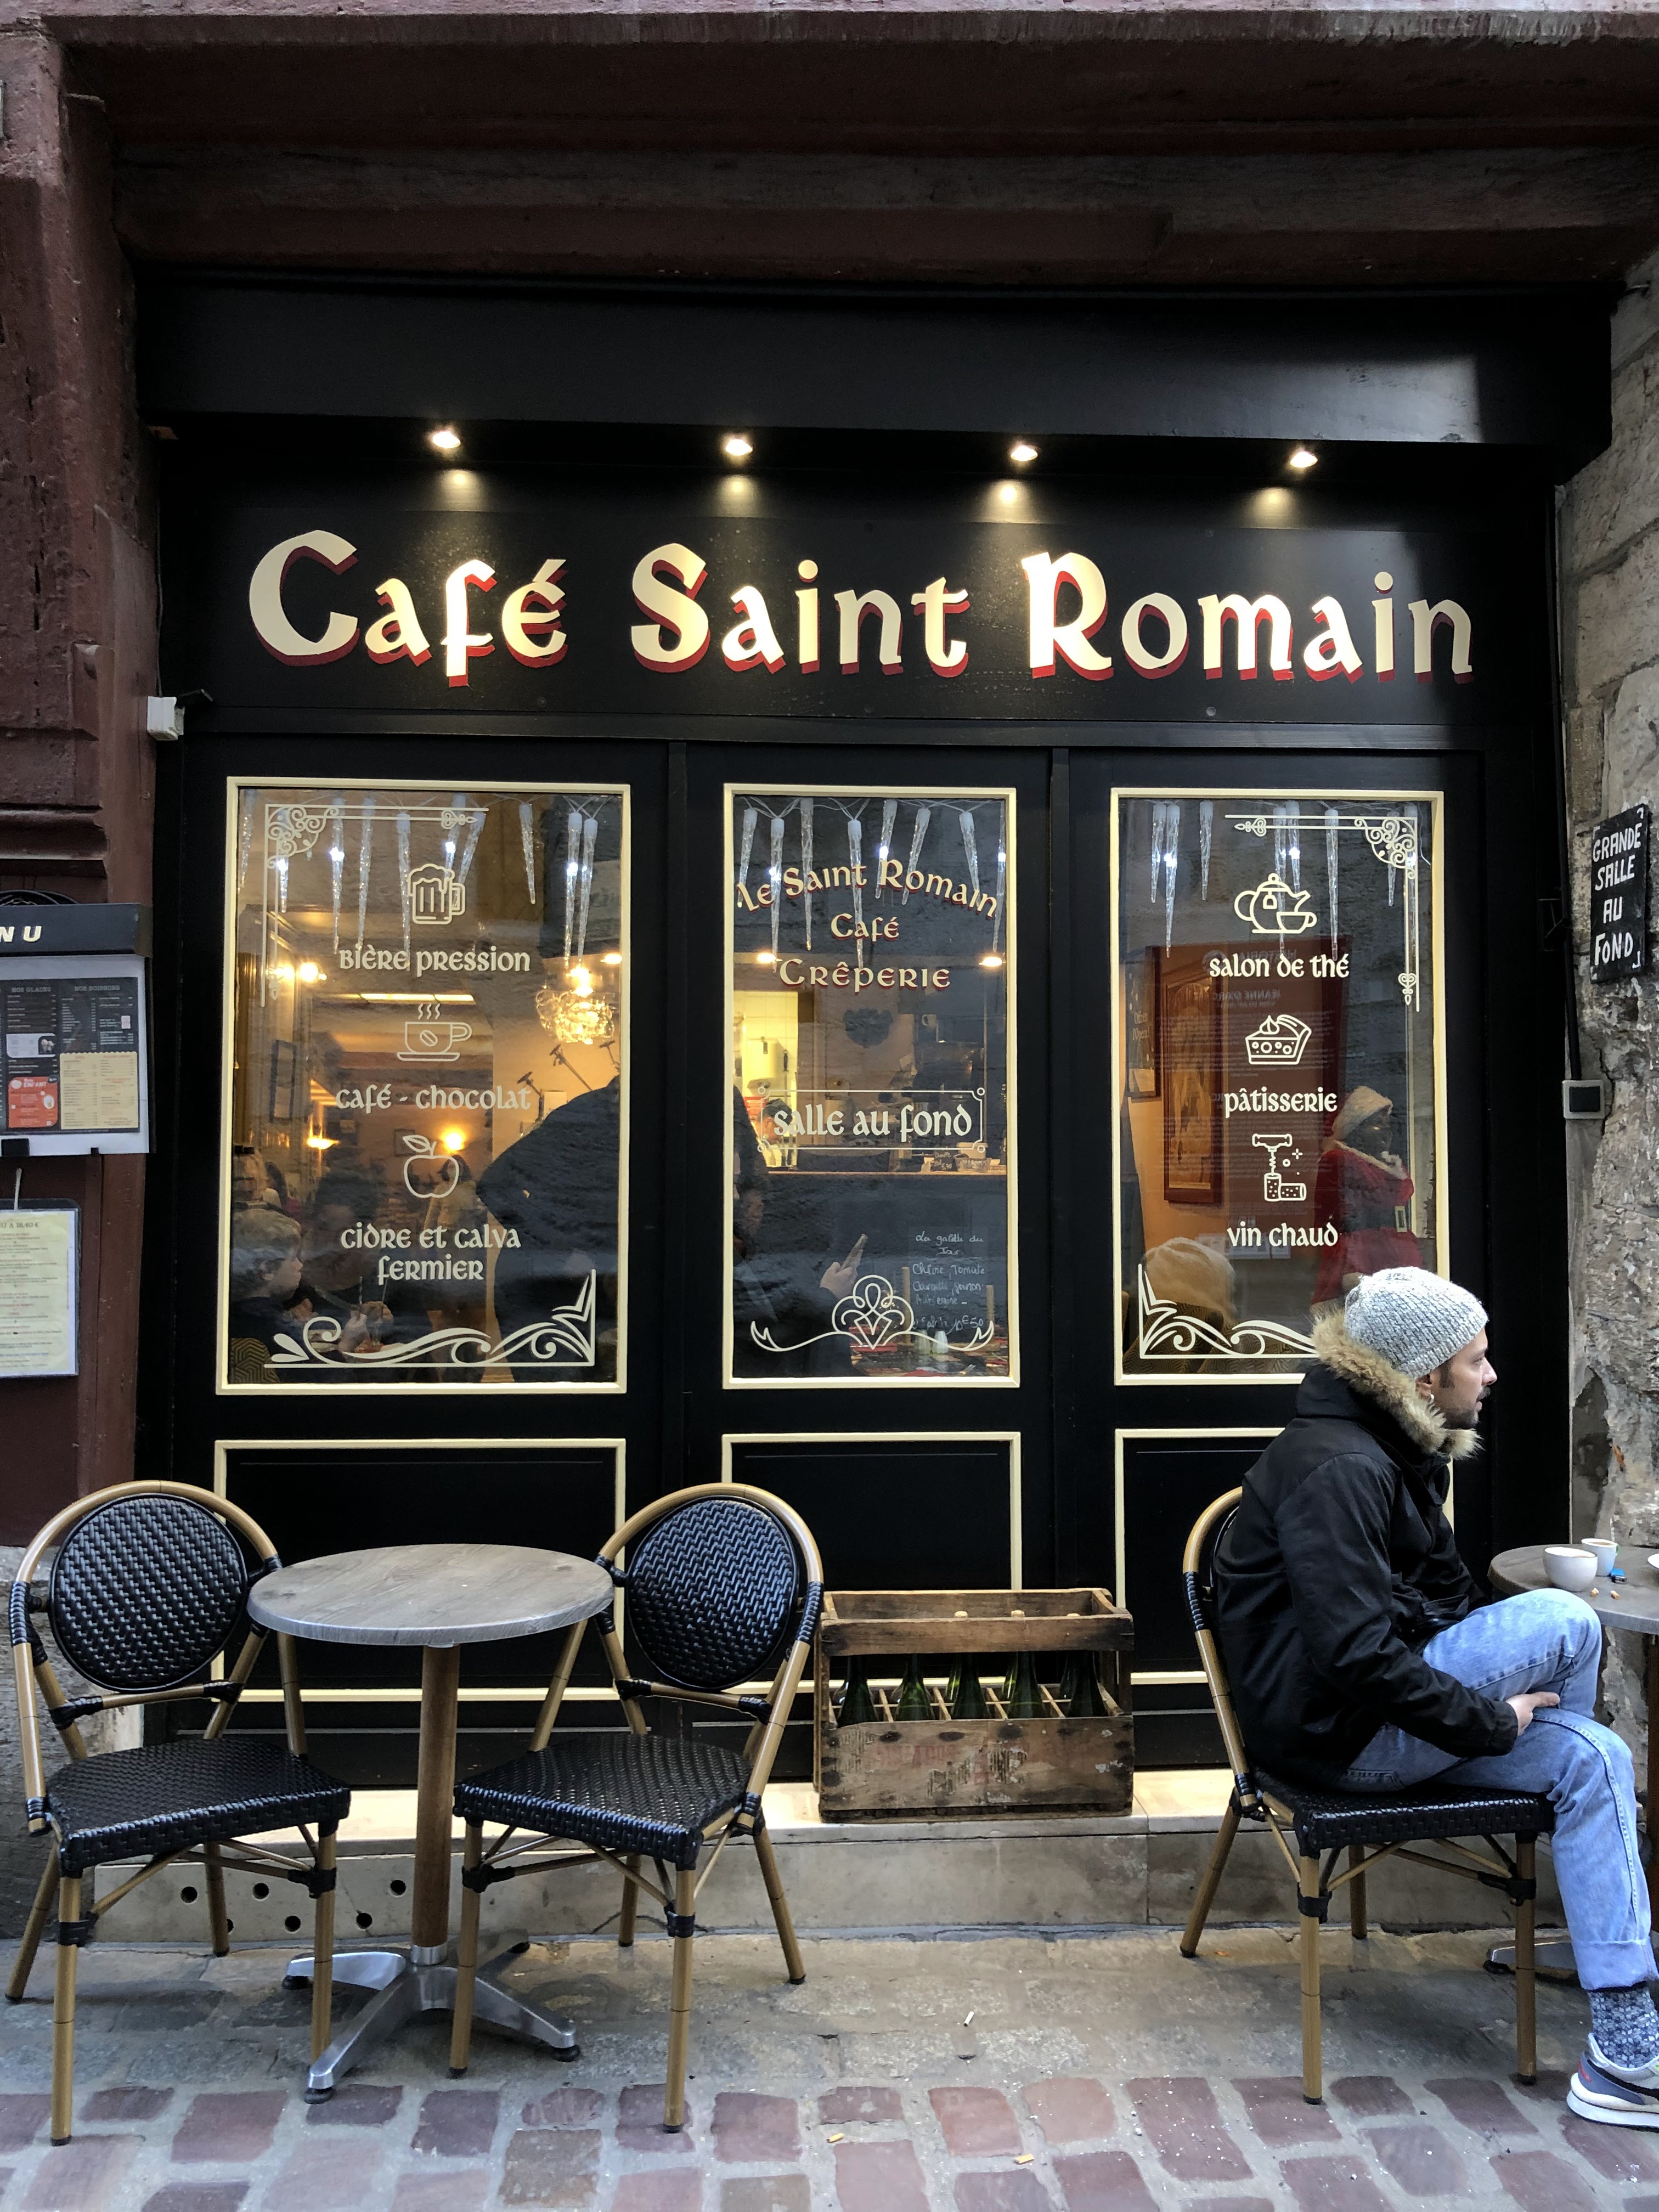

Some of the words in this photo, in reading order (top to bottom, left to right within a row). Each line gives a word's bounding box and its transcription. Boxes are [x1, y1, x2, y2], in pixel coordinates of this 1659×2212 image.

[250, 530, 568, 687] Café
[631, 543, 970, 677] Saint
[1022, 552, 1473, 683] Romain
[1593, 823, 1642, 862] GRANDE
[1595, 855, 1635, 891] SALLE
[783, 864, 866, 899] Saint
[879, 859, 997, 920] Romain
[1603, 896, 1623, 924] AU
[831, 913, 899, 942] Café
[416, 946, 530, 977] pression
[1594, 932, 1633, 966] FOND
[1210, 953, 1269, 978] salon
[1277, 953, 1305, 978] de
[1310, 953, 1349, 978] thé
[336, 1084, 392, 1114] café
[416, 1085, 531, 1109] chocolat
[1224, 1086, 1338, 1118] pâtisserie
[774, 1104, 844, 1136] salle
[853, 1110, 890, 1136] au
[900, 1104, 972, 1142] fond
[341, 1222, 411, 1249] cidre
[420, 1225, 448, 1249] et
[455, 1223, 522, 1249] calva
[916, 1231, 930, 1242] La
[1227, 1221, 1262, 1248] vin
[1269, 1222, 1339, 1248] chaud
[378, 1254, 484, 1285] fermier
